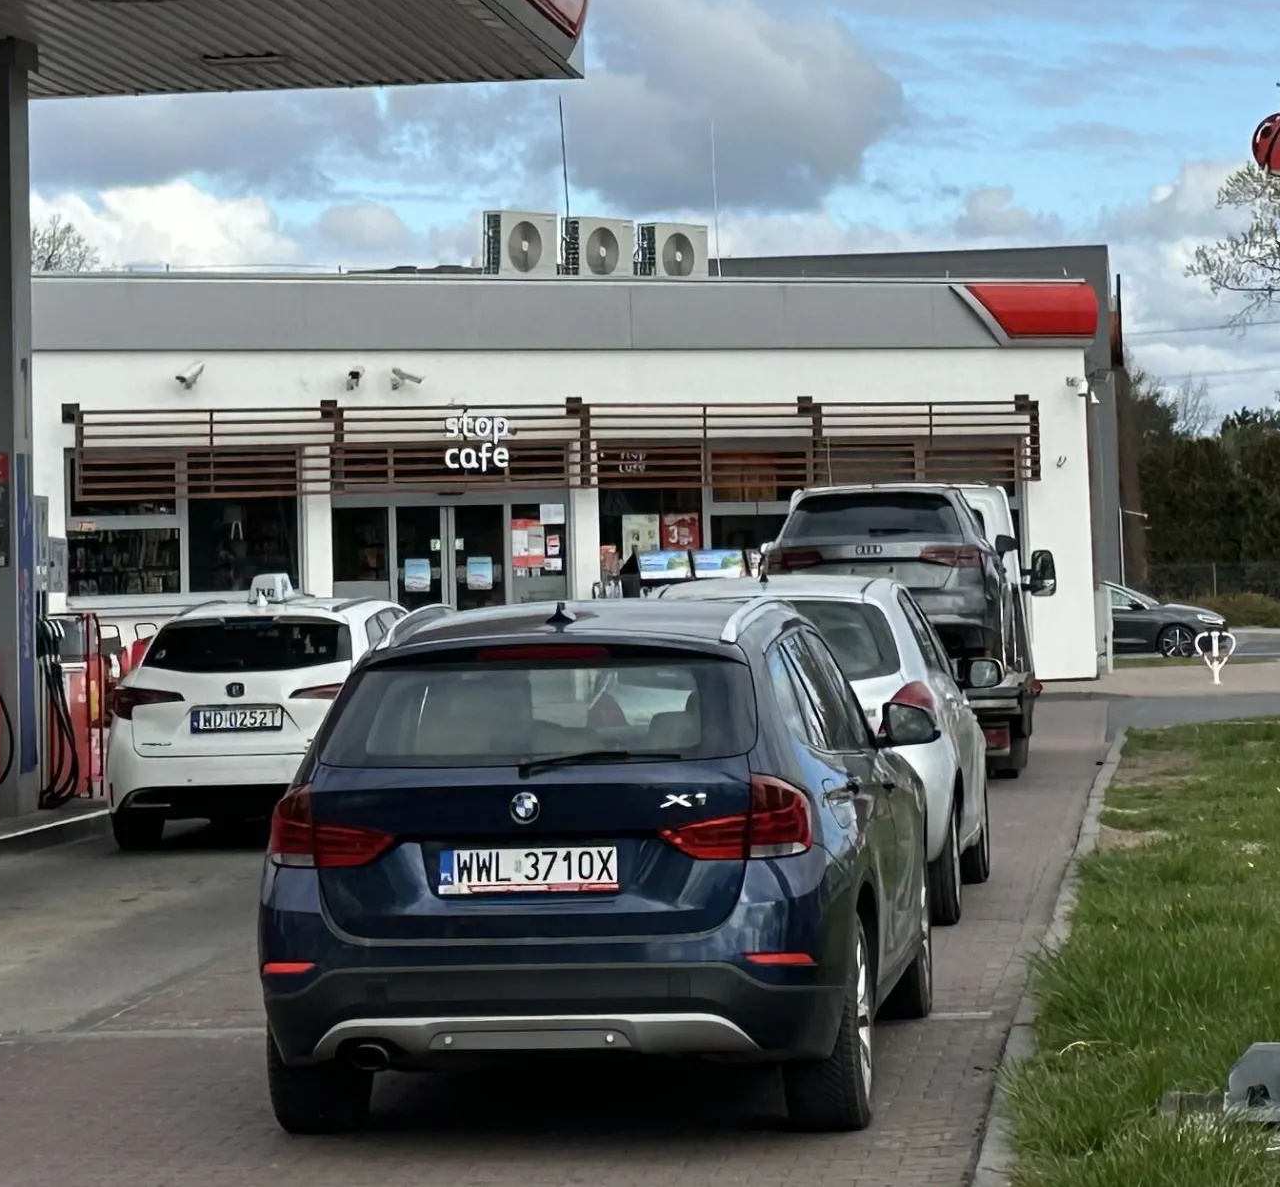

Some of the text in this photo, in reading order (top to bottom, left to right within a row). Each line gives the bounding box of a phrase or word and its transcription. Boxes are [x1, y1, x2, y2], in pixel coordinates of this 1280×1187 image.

[444, 443, 510, 472] cafe
[456, 849, 614, 883] WWL 3710X
